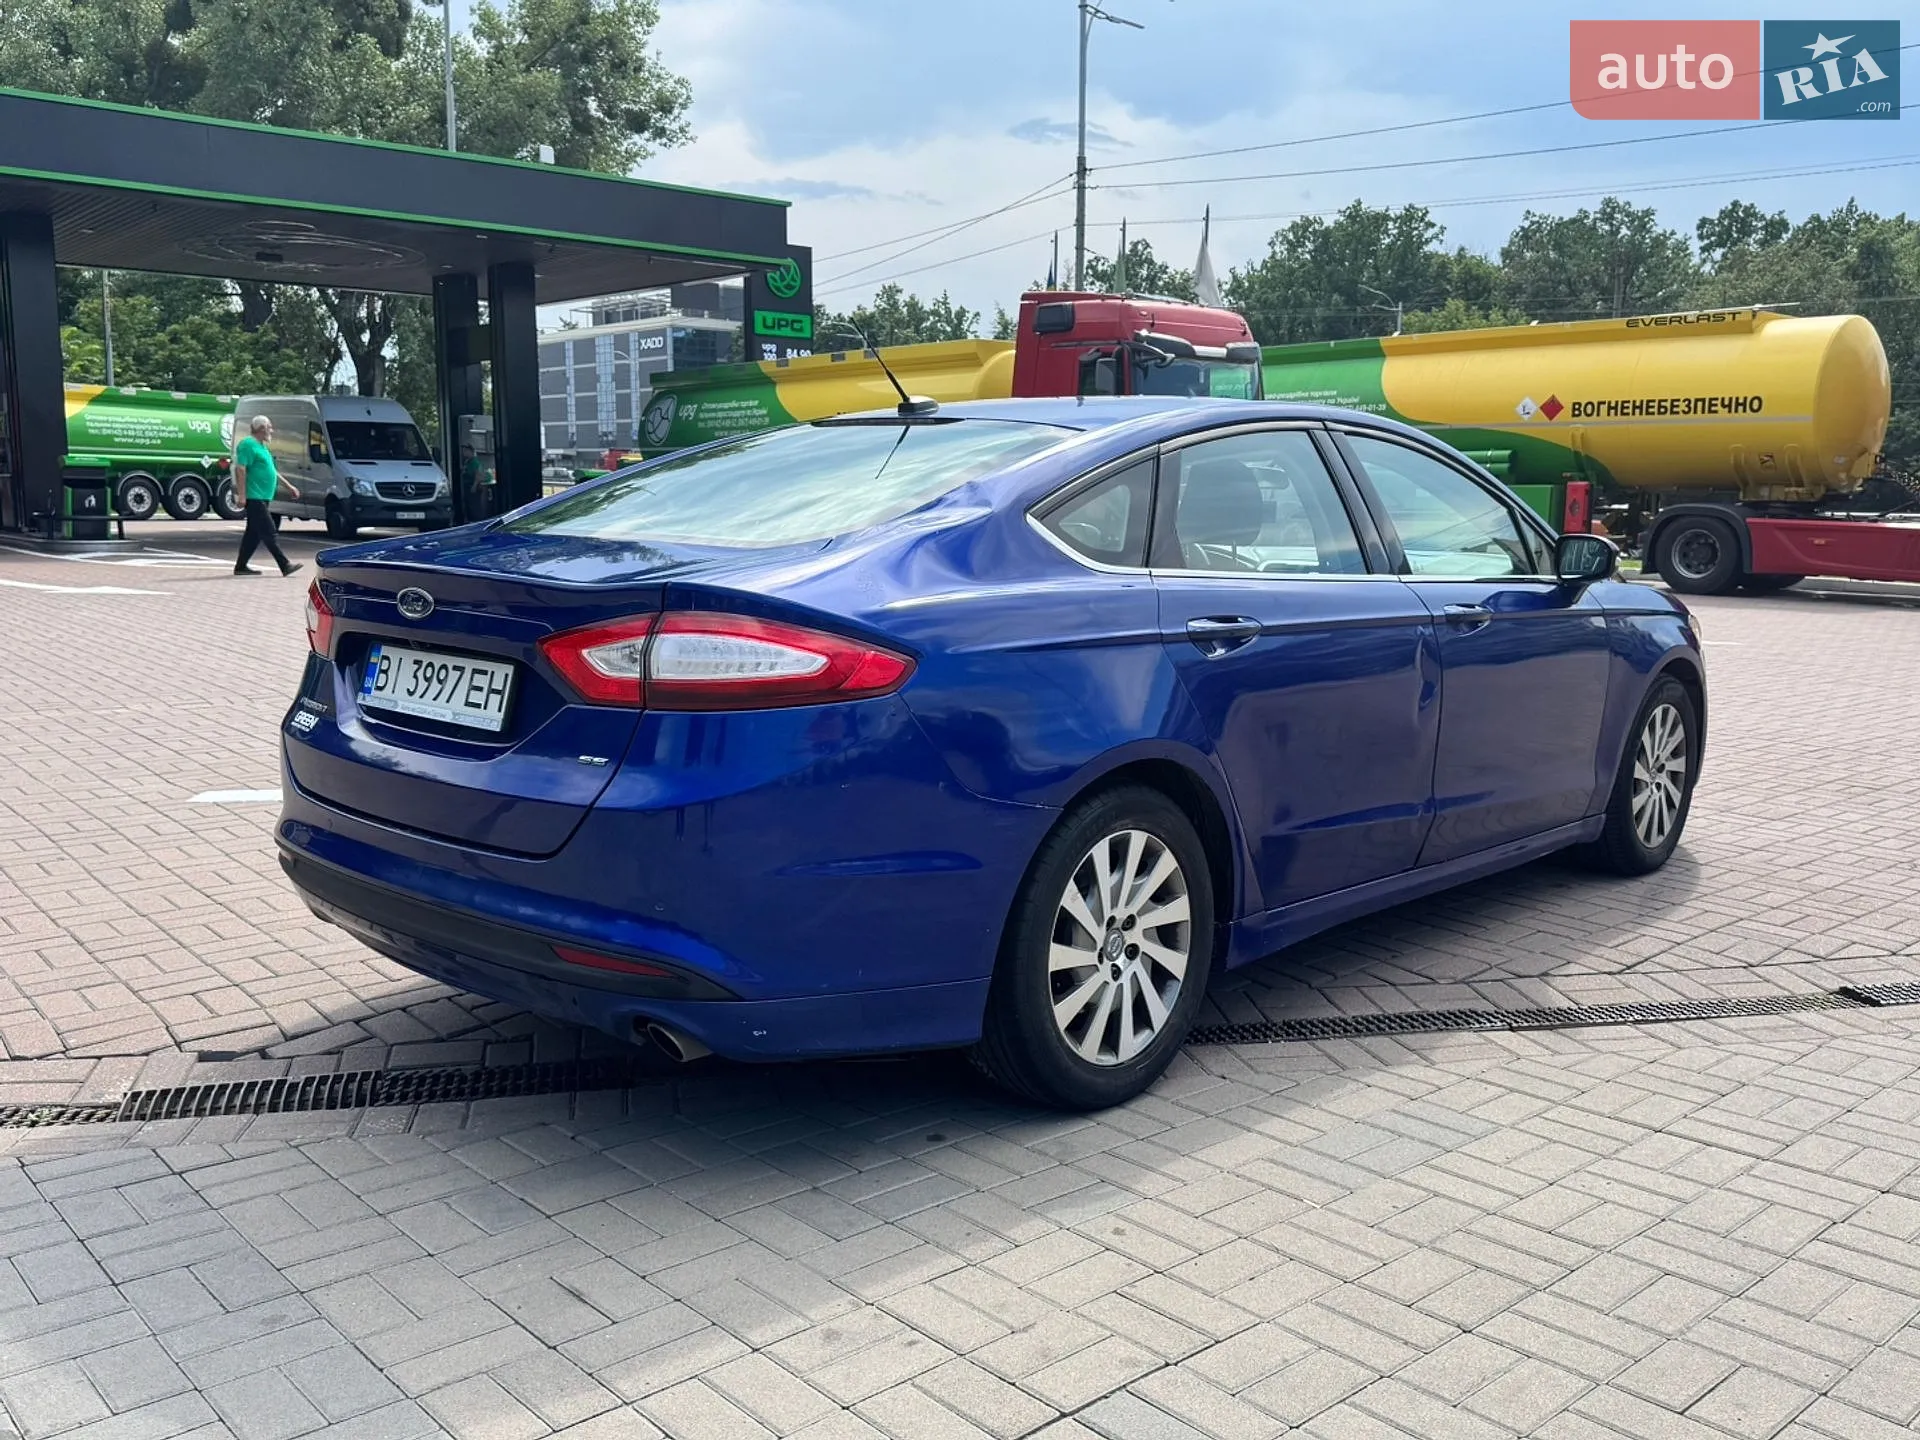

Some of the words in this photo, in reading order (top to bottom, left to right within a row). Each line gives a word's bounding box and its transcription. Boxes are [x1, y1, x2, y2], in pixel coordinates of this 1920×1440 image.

[762, 315, 804, 333] UPG
[1625, 311, 1742, 328] EVERLAST
[678, 404, 698, 421] upg
[1571, 395, 1764, 418] ВОГНЕНЕБЕЗПЕЧНО
[187, 419, 212, 433] upg
[406, 659, 466, 703] 3997
[464, 668, 510, 713] EH
